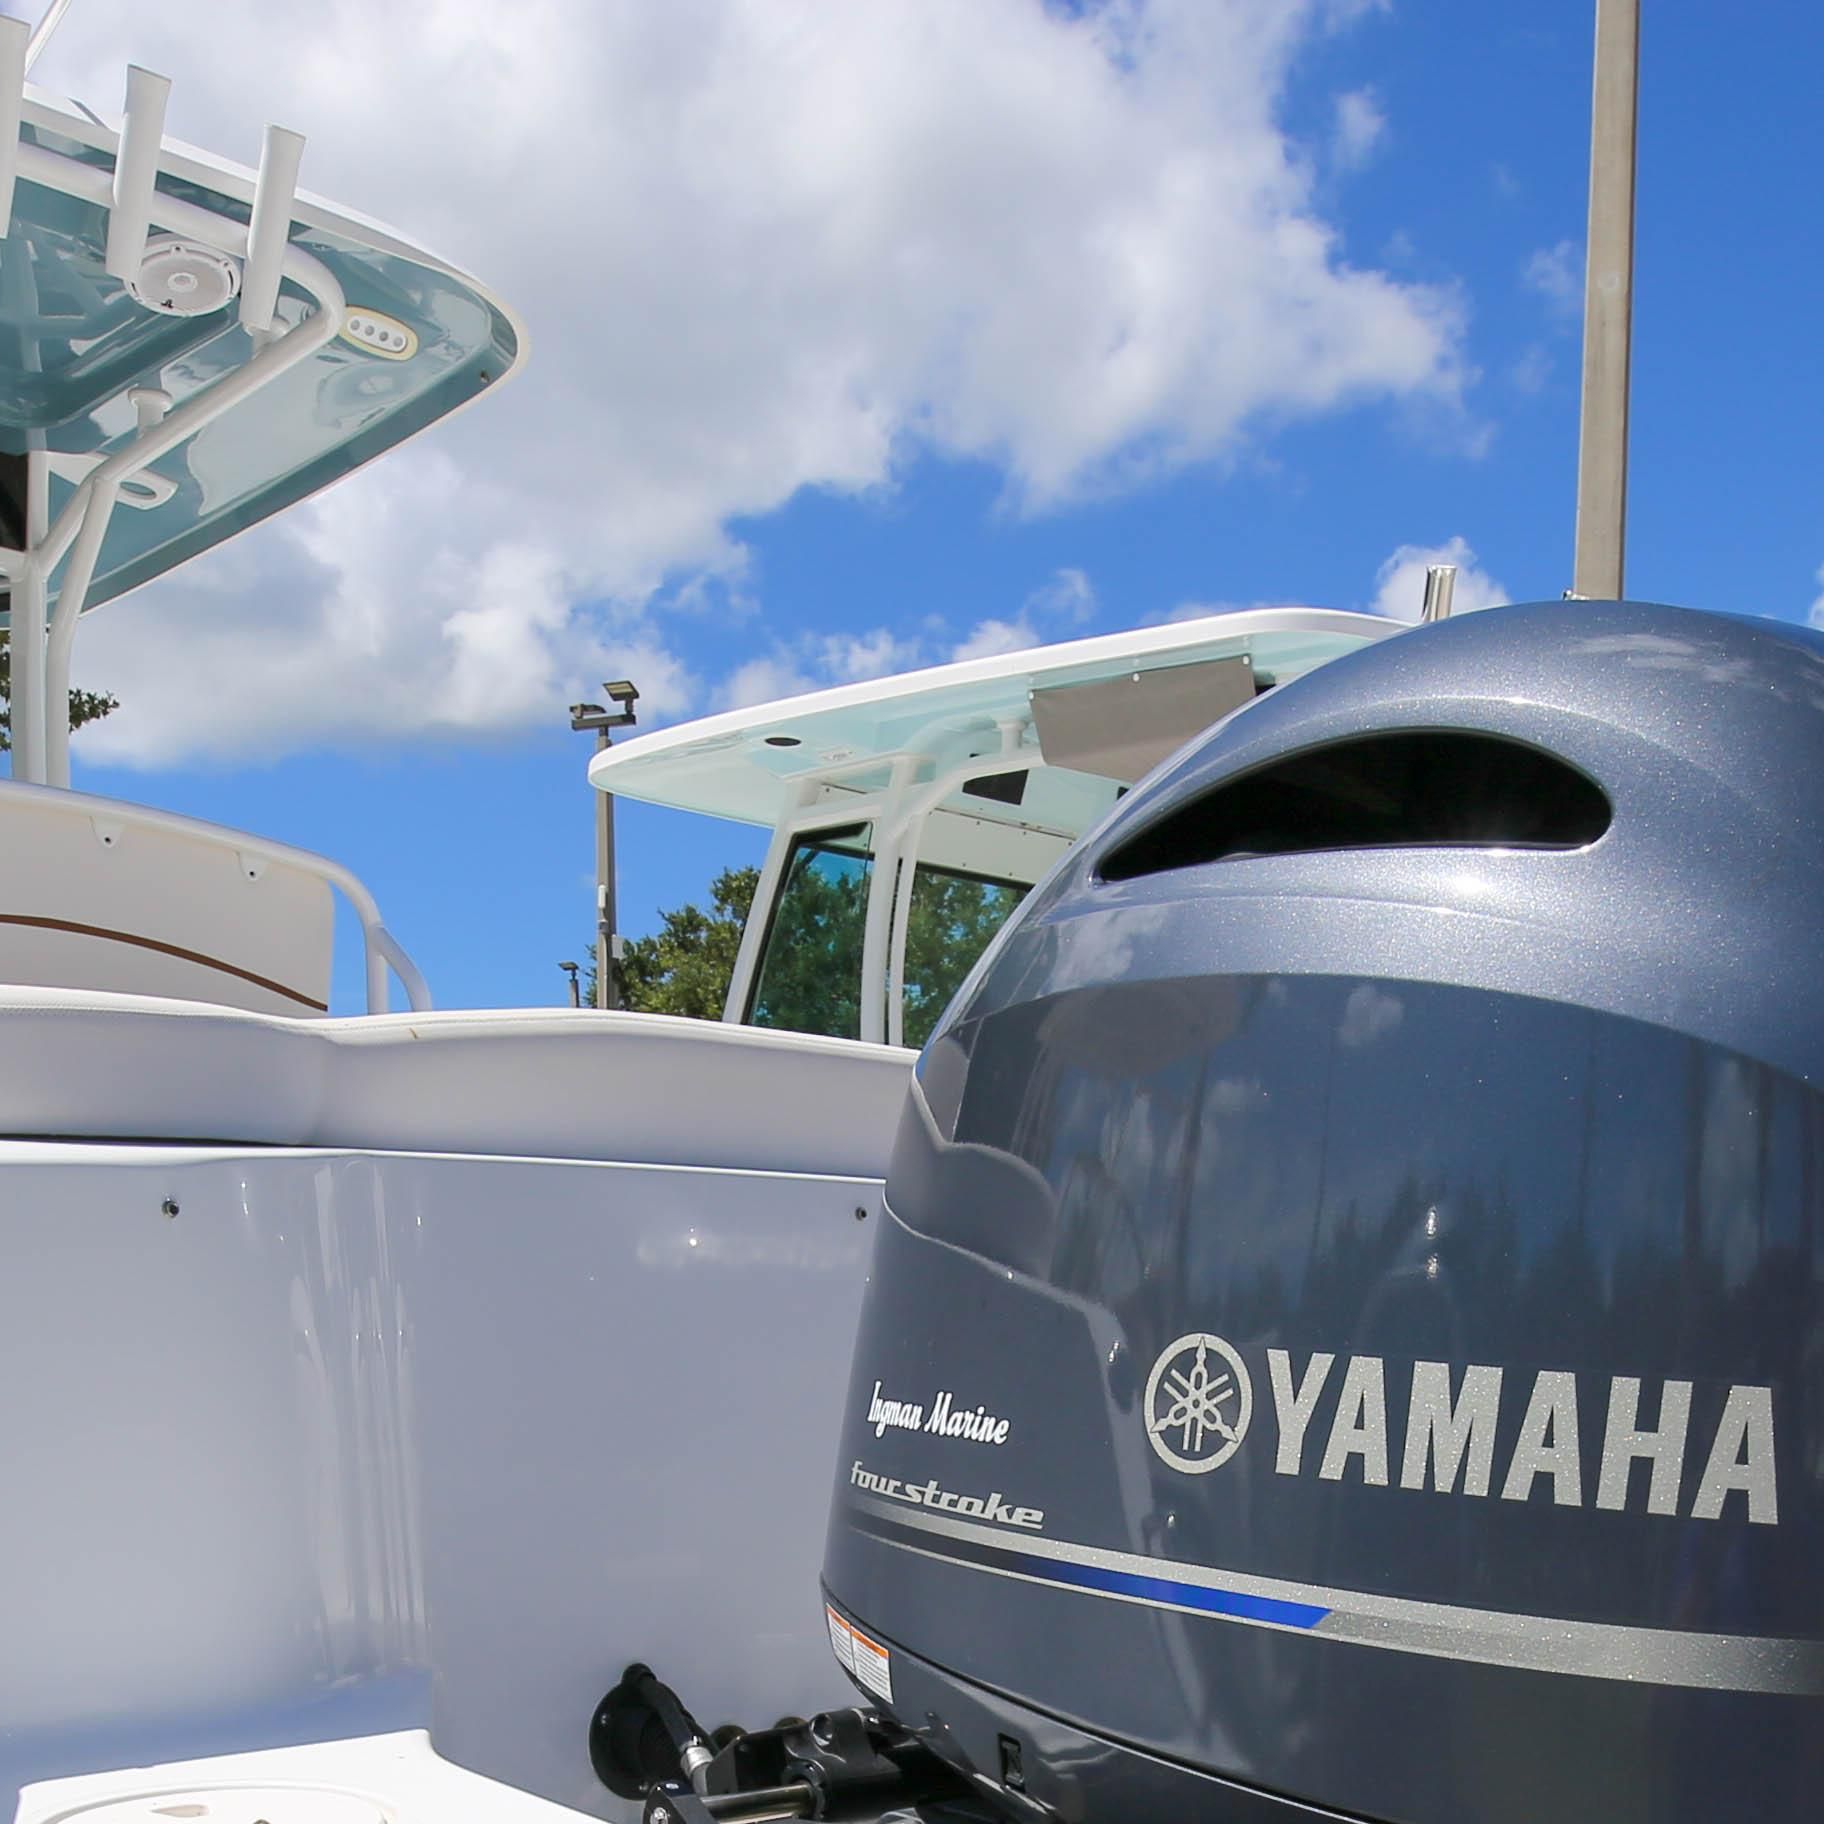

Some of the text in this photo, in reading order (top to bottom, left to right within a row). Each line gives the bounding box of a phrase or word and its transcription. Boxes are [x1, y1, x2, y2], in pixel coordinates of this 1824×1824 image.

[866, 1379, 1010, 1445] Ingman Marine
[1266, 1348, 1779, 1525] YAMAHA
